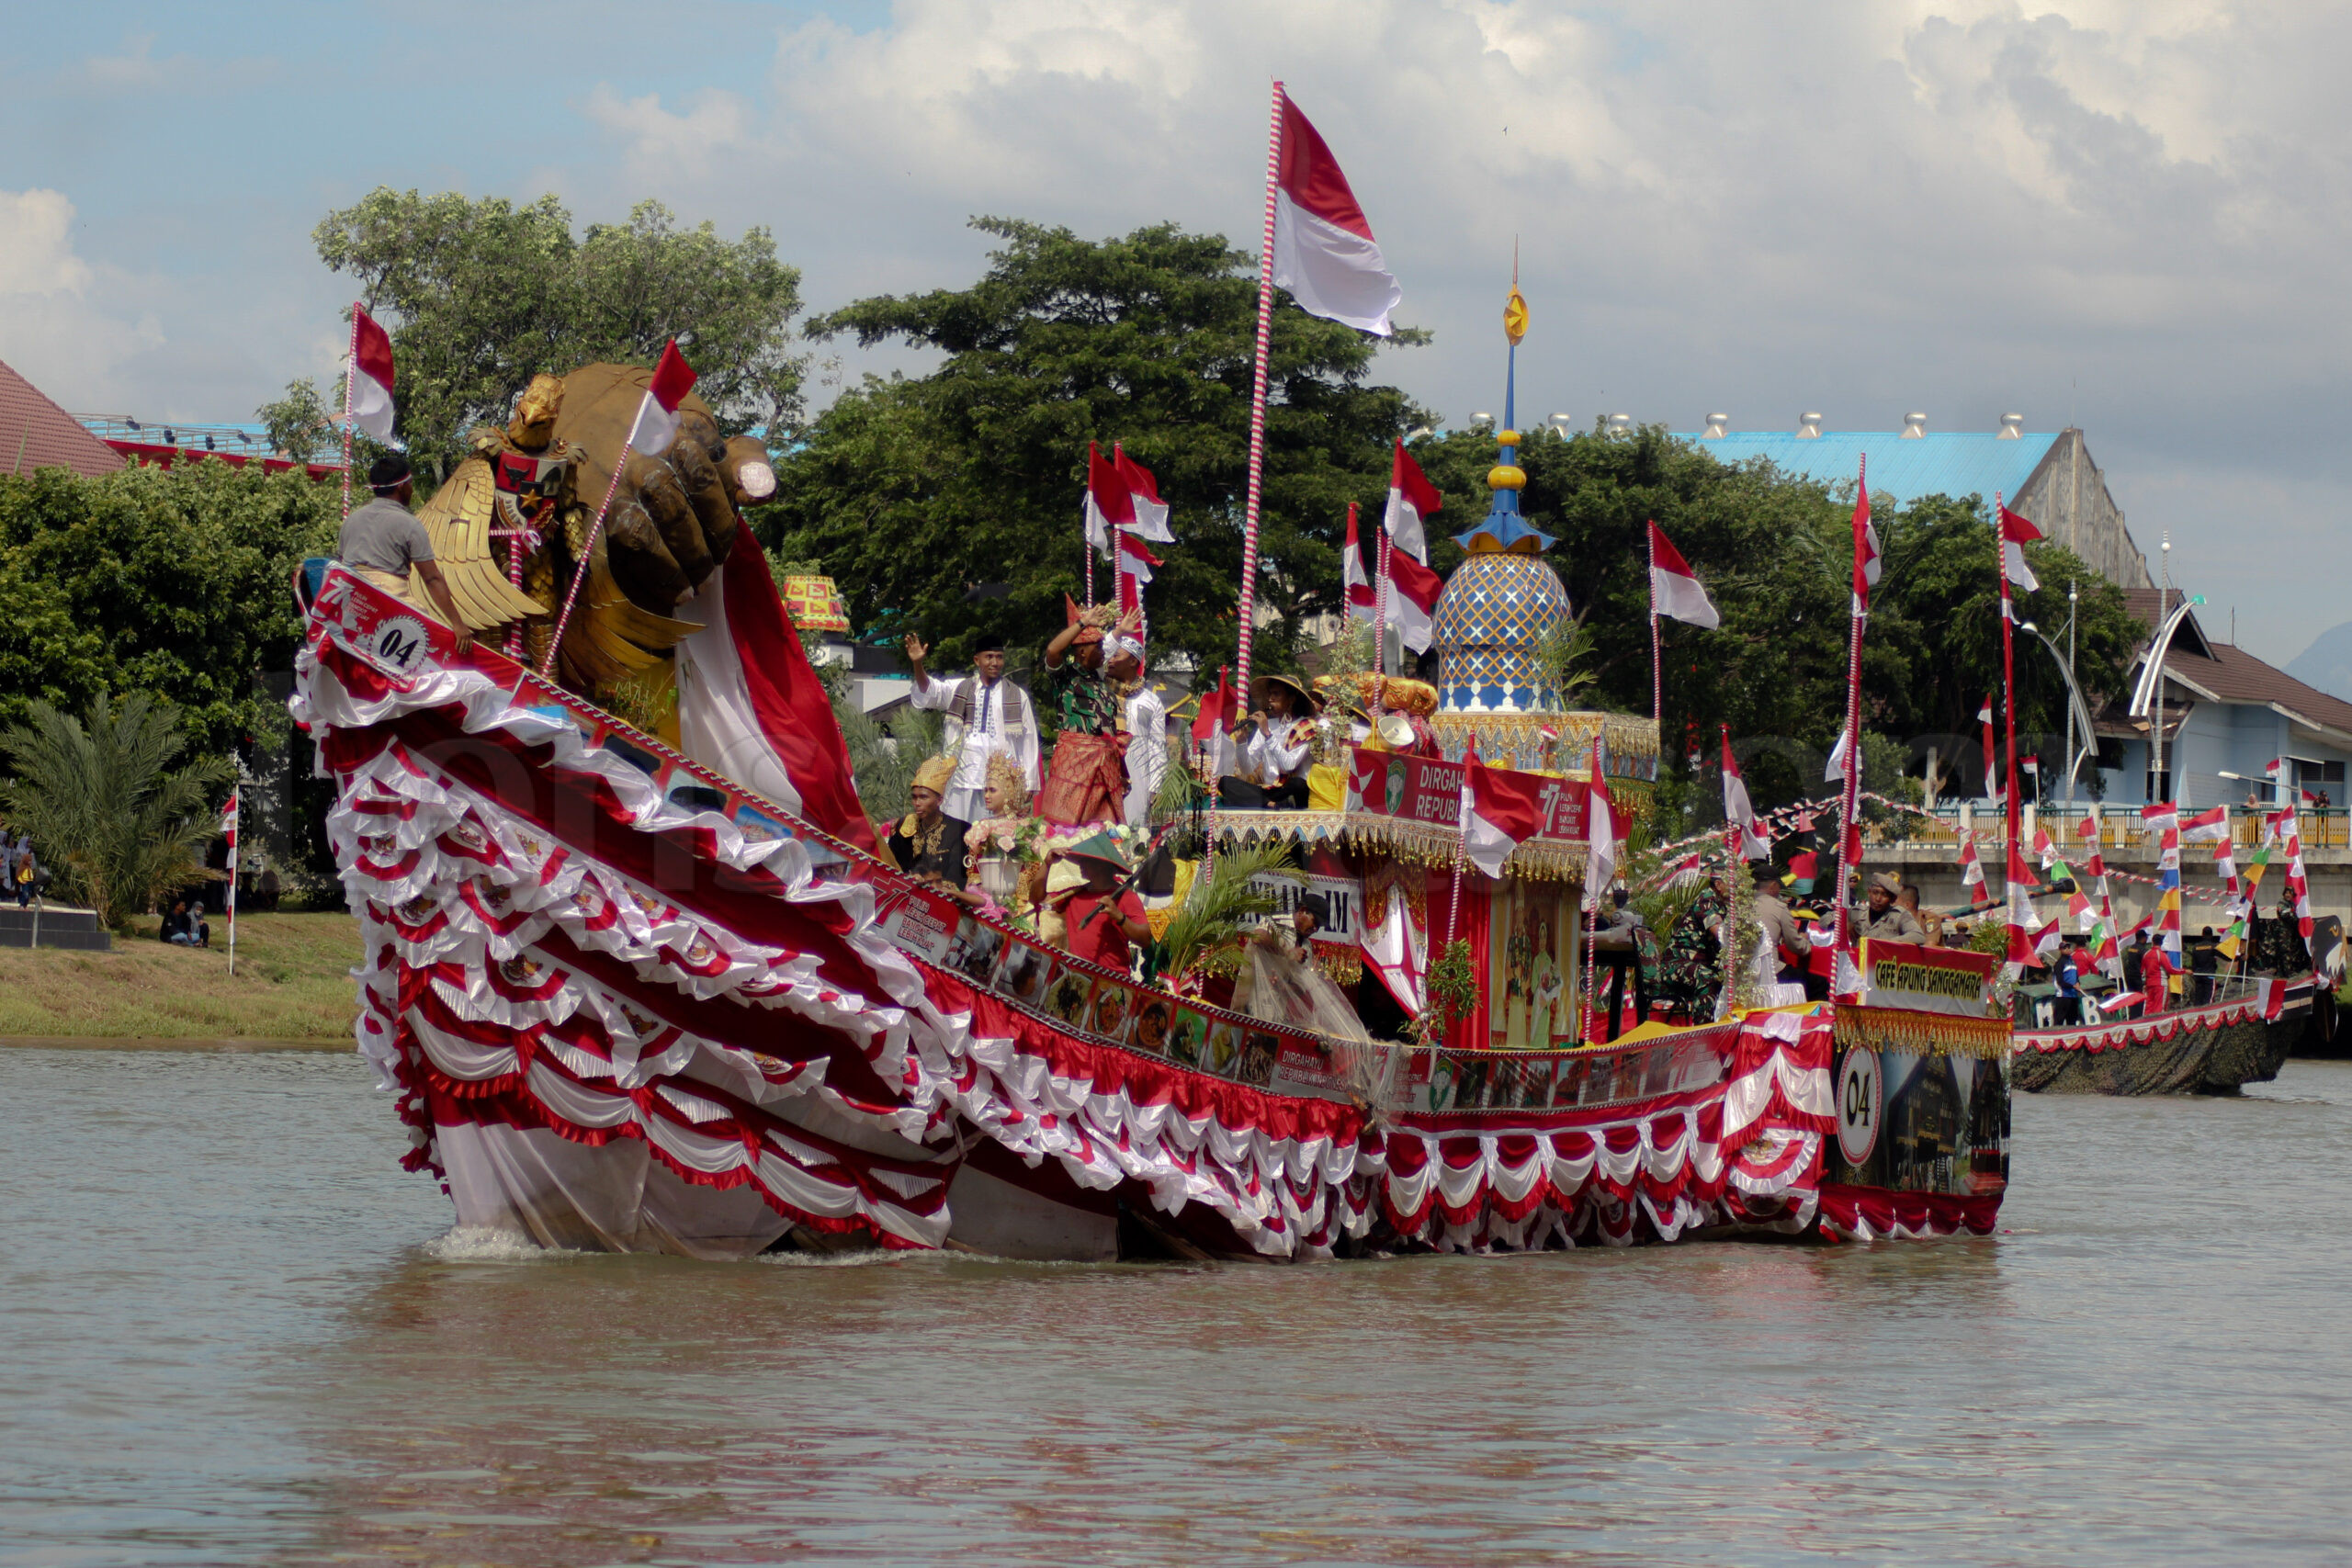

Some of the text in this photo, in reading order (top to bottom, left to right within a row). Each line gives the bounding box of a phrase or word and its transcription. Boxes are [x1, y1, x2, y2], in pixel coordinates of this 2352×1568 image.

[379, 629, 419, 669] 04
[1419, 765, 1464, 793] DIRGAH
[1416, 795, 1459, 822] REPUBL
[898, 926, 918, 942] LEBIH
[923, 915, 947, 933] CEPAT
[1875, 955, 1983, 1001] CAFÉ APUNG SANGGAMARA
[1282, 1050, 1324, 1071] DIRGAHAYU
[1847, 1069, 1871, 1128] 04
